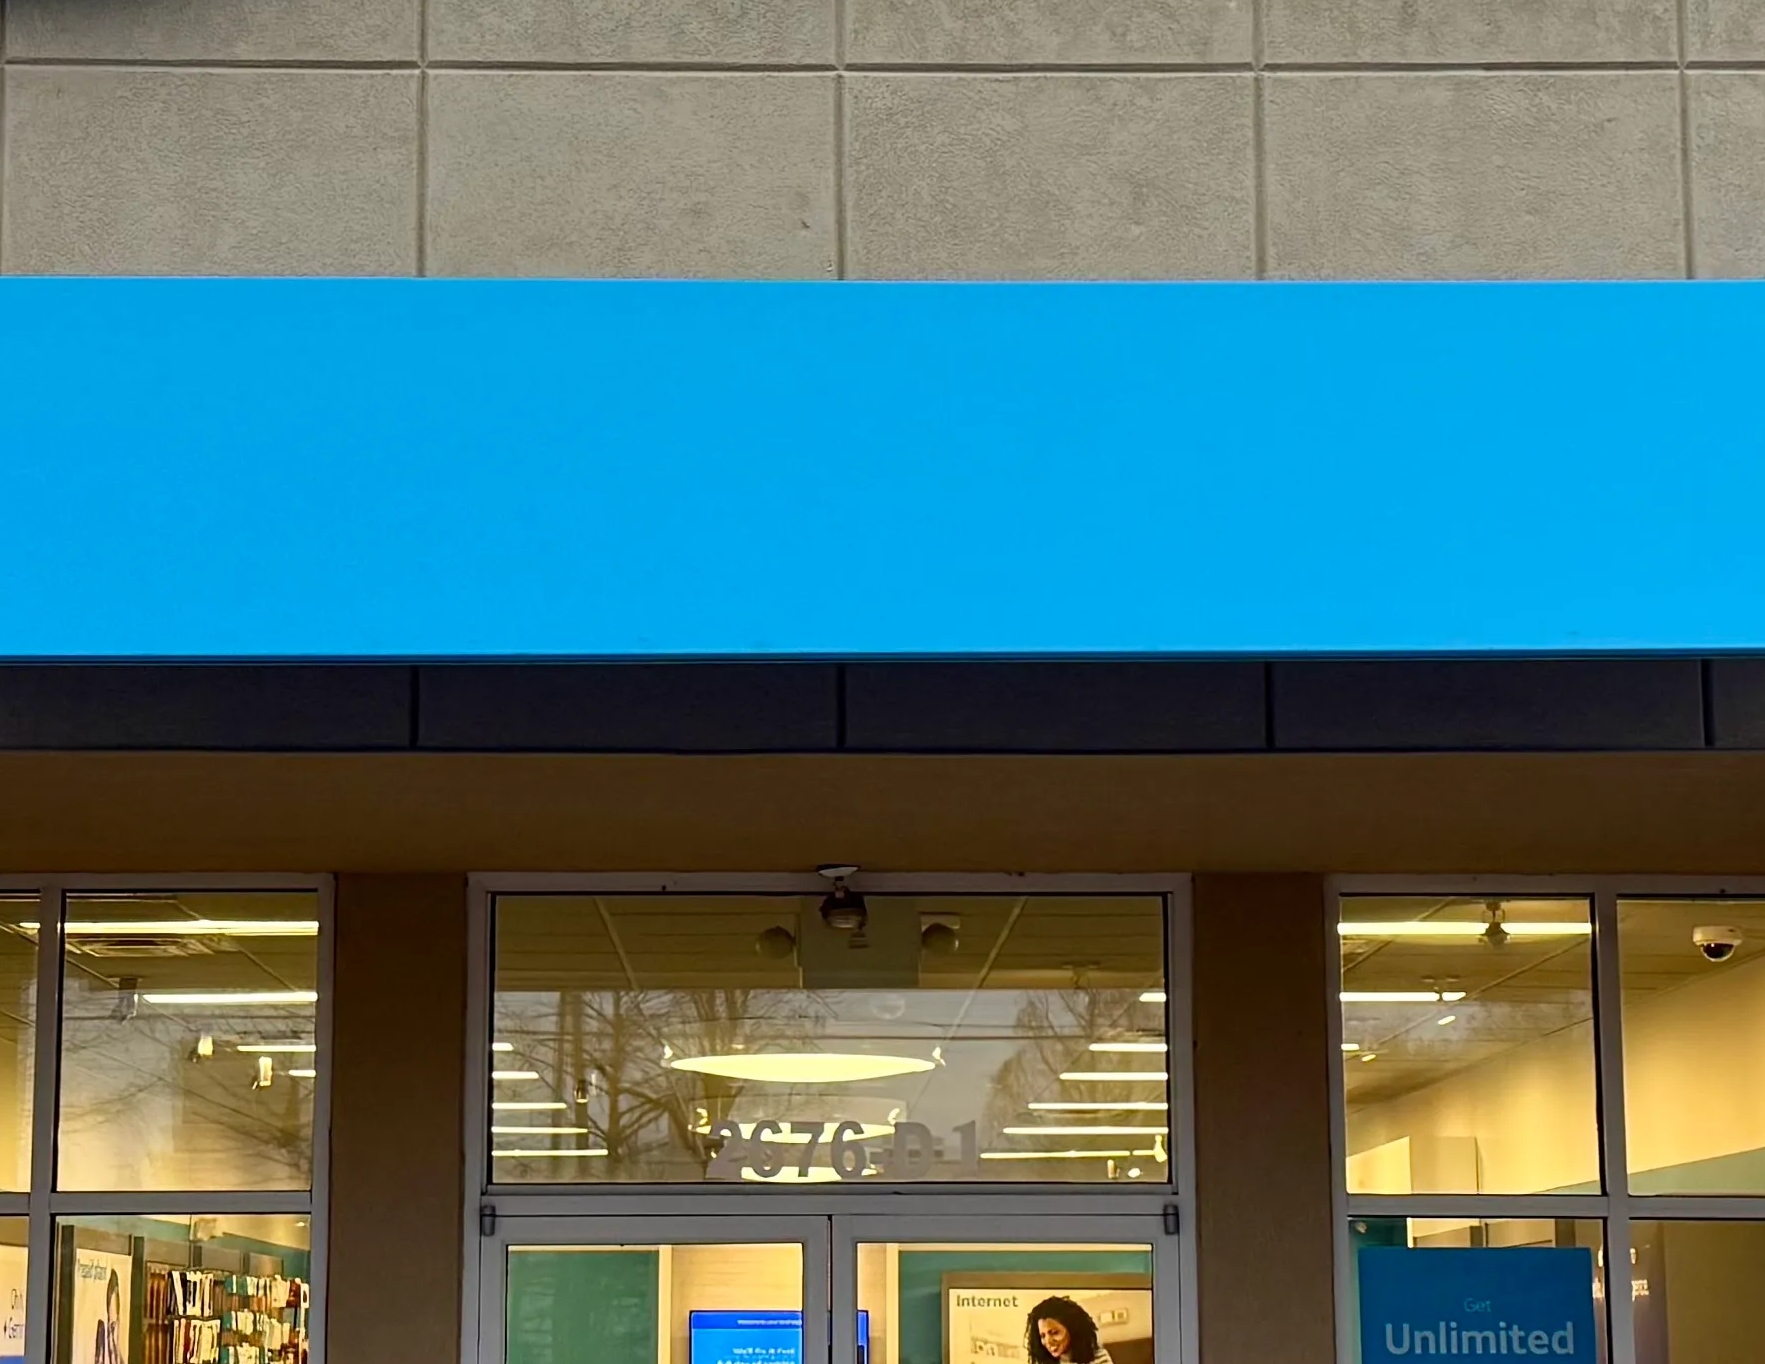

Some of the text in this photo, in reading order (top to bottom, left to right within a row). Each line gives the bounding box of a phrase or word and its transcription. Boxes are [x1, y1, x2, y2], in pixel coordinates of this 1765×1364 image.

[956, 1294, 1019, 1308] Internet
[1463, 1297, 1492, 1313] Get
[1385, 1321, 1575, 1355] Unlimited
